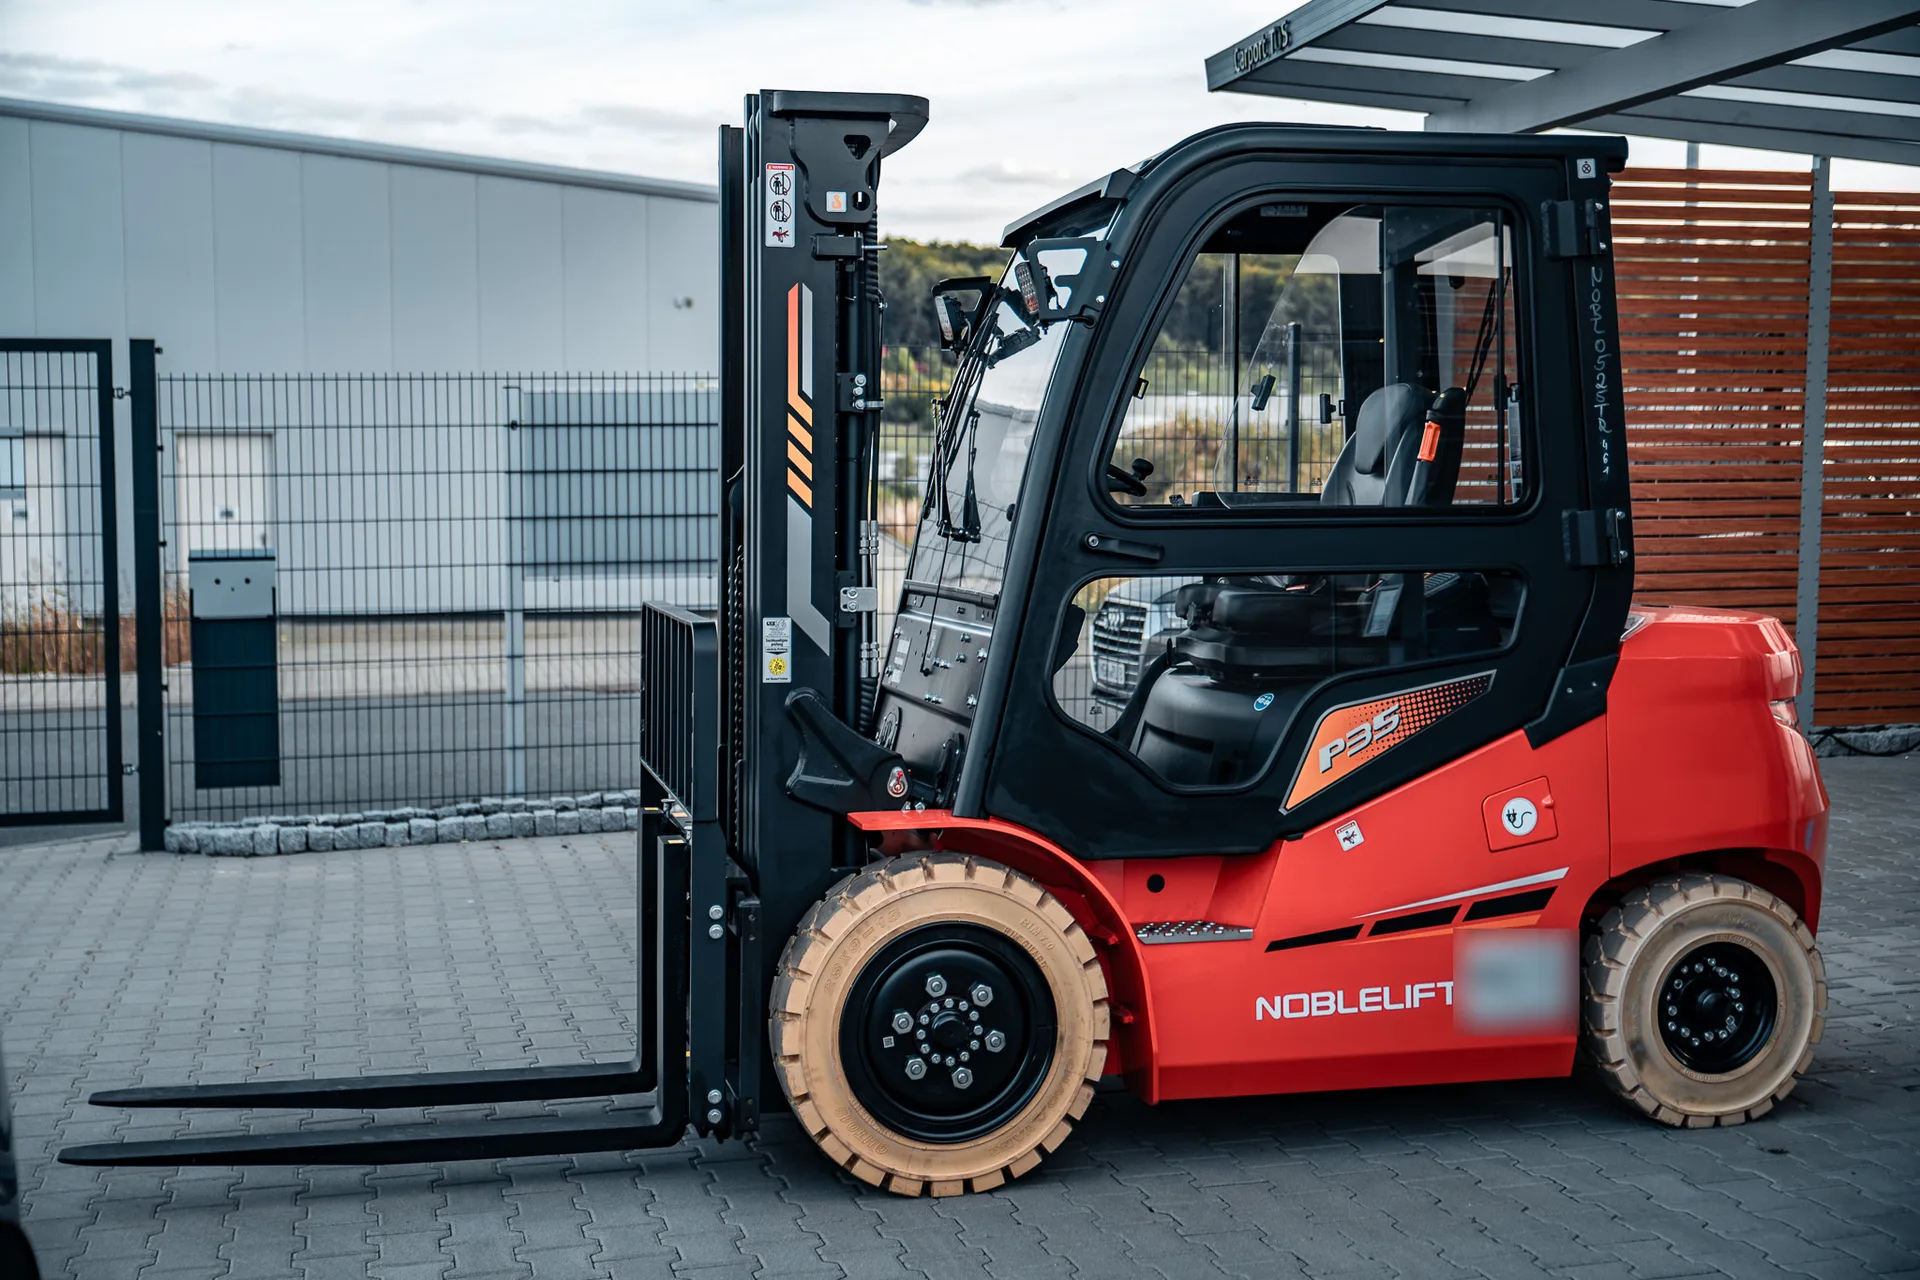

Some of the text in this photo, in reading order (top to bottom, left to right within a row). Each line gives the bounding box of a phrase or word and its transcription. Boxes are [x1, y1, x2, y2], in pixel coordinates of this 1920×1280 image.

[1233, 34, 1268, 73] Carport
[1318, 703, 1401, 774] P35
[1255, 979, 1454, 1022] NOBLELIFT
